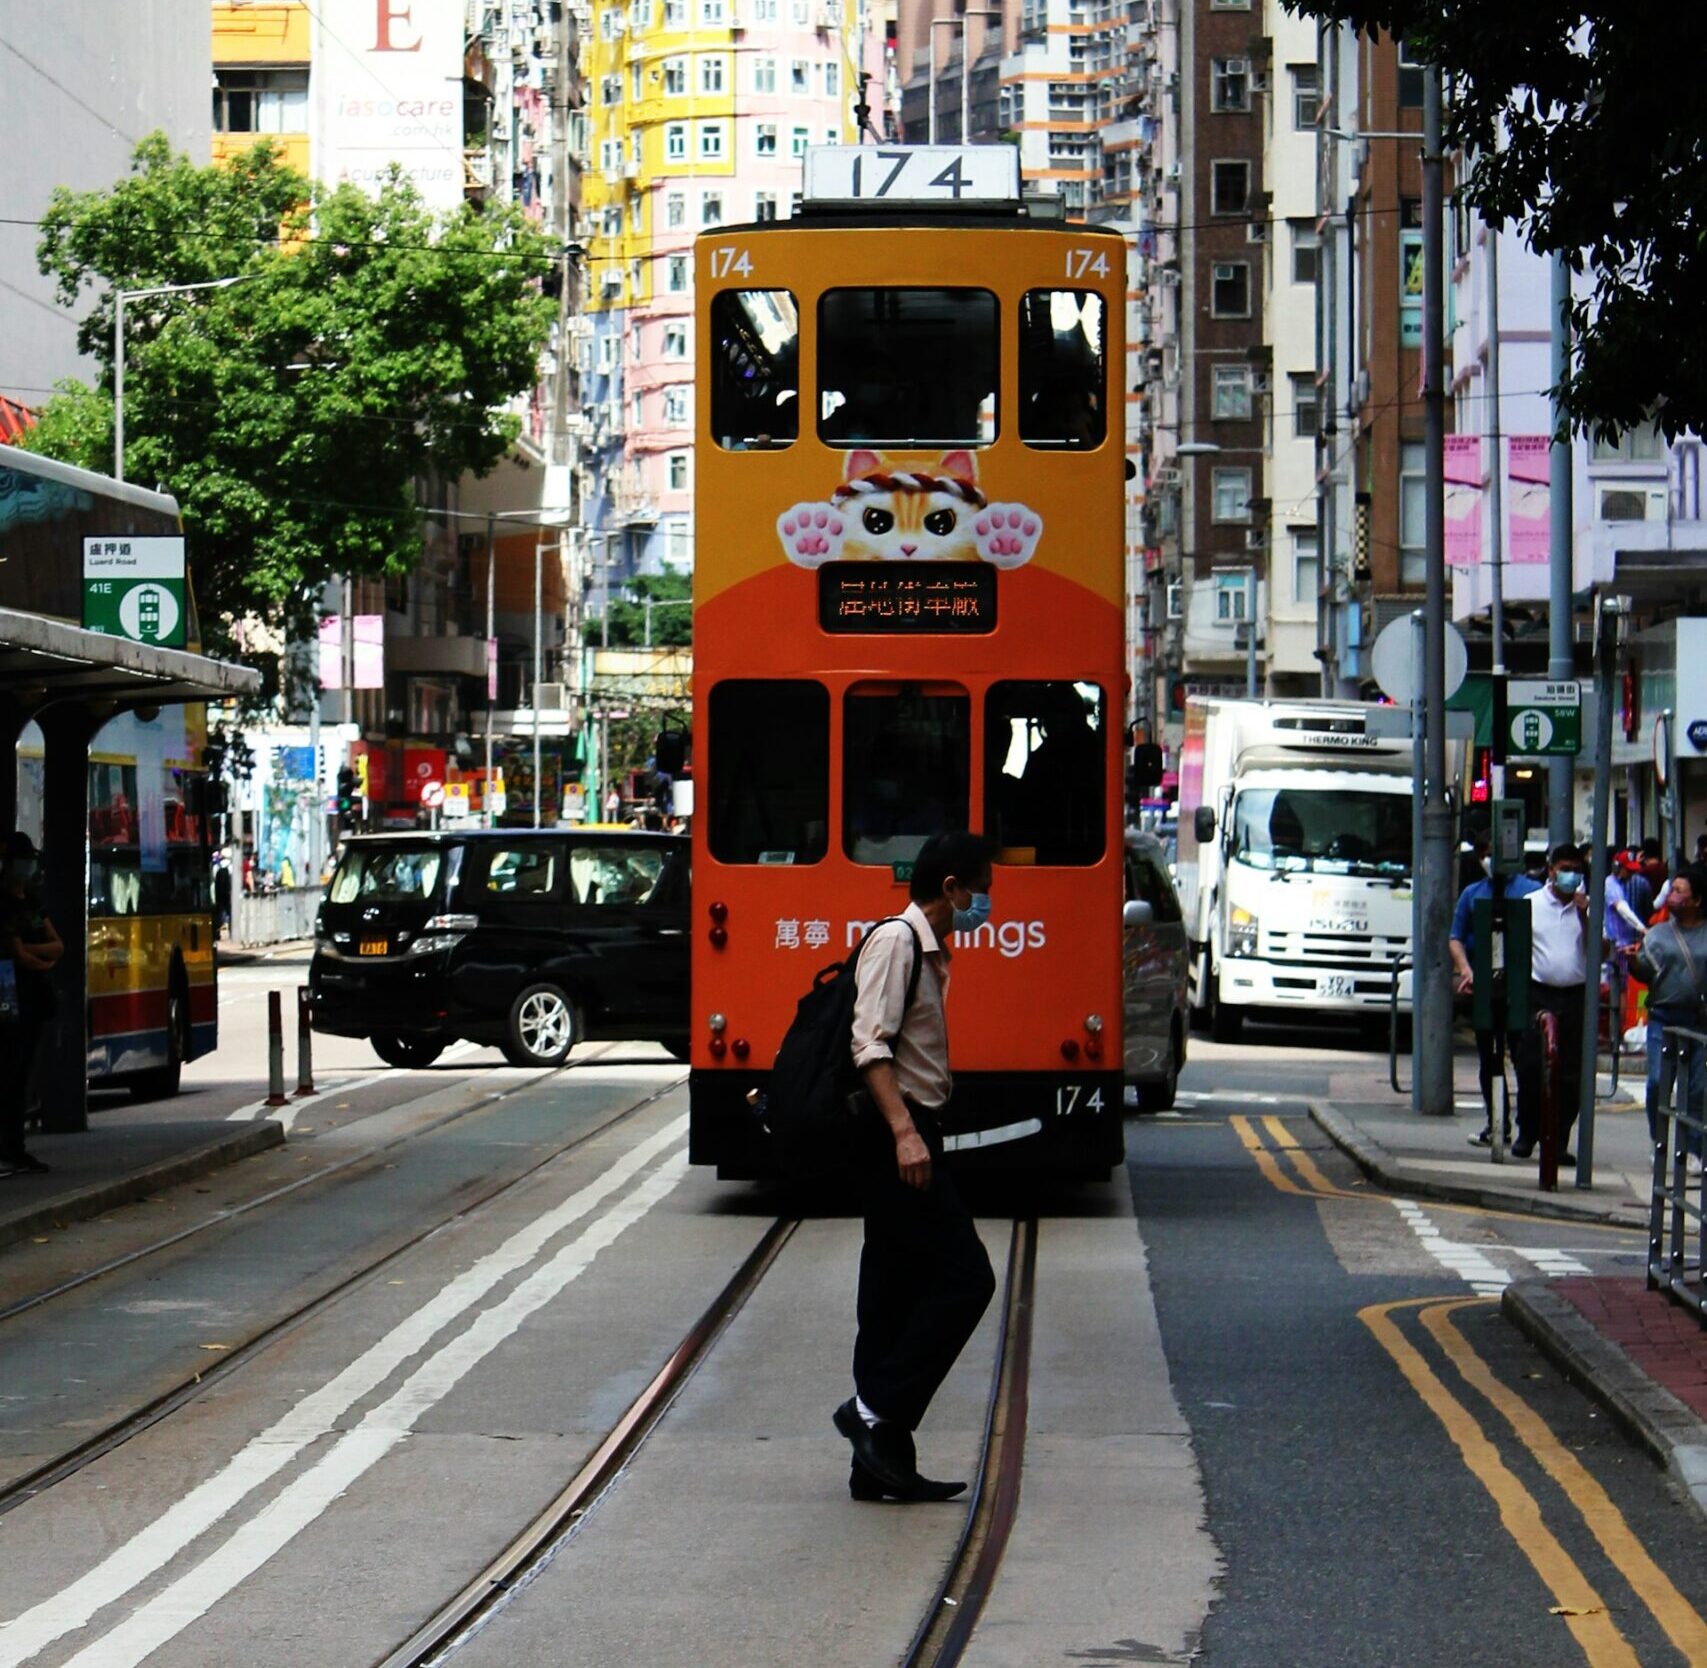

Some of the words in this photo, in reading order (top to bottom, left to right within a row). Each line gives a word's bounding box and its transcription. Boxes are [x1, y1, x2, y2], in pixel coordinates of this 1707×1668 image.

[367, 0, 423, 52] E
[853, 152, 973, 199] 174
[710, 247, 754, 279] 174
[1065, 249, 1110, 279] 174
[89, 583, 112, 594] 41E
[1303, 735, 1349, 746] THERMO
[1351, 737, 1378, 747] KING
[775, 918, 831, 950] 萬寧
[1056, 1086, 1105, 1115] 174
